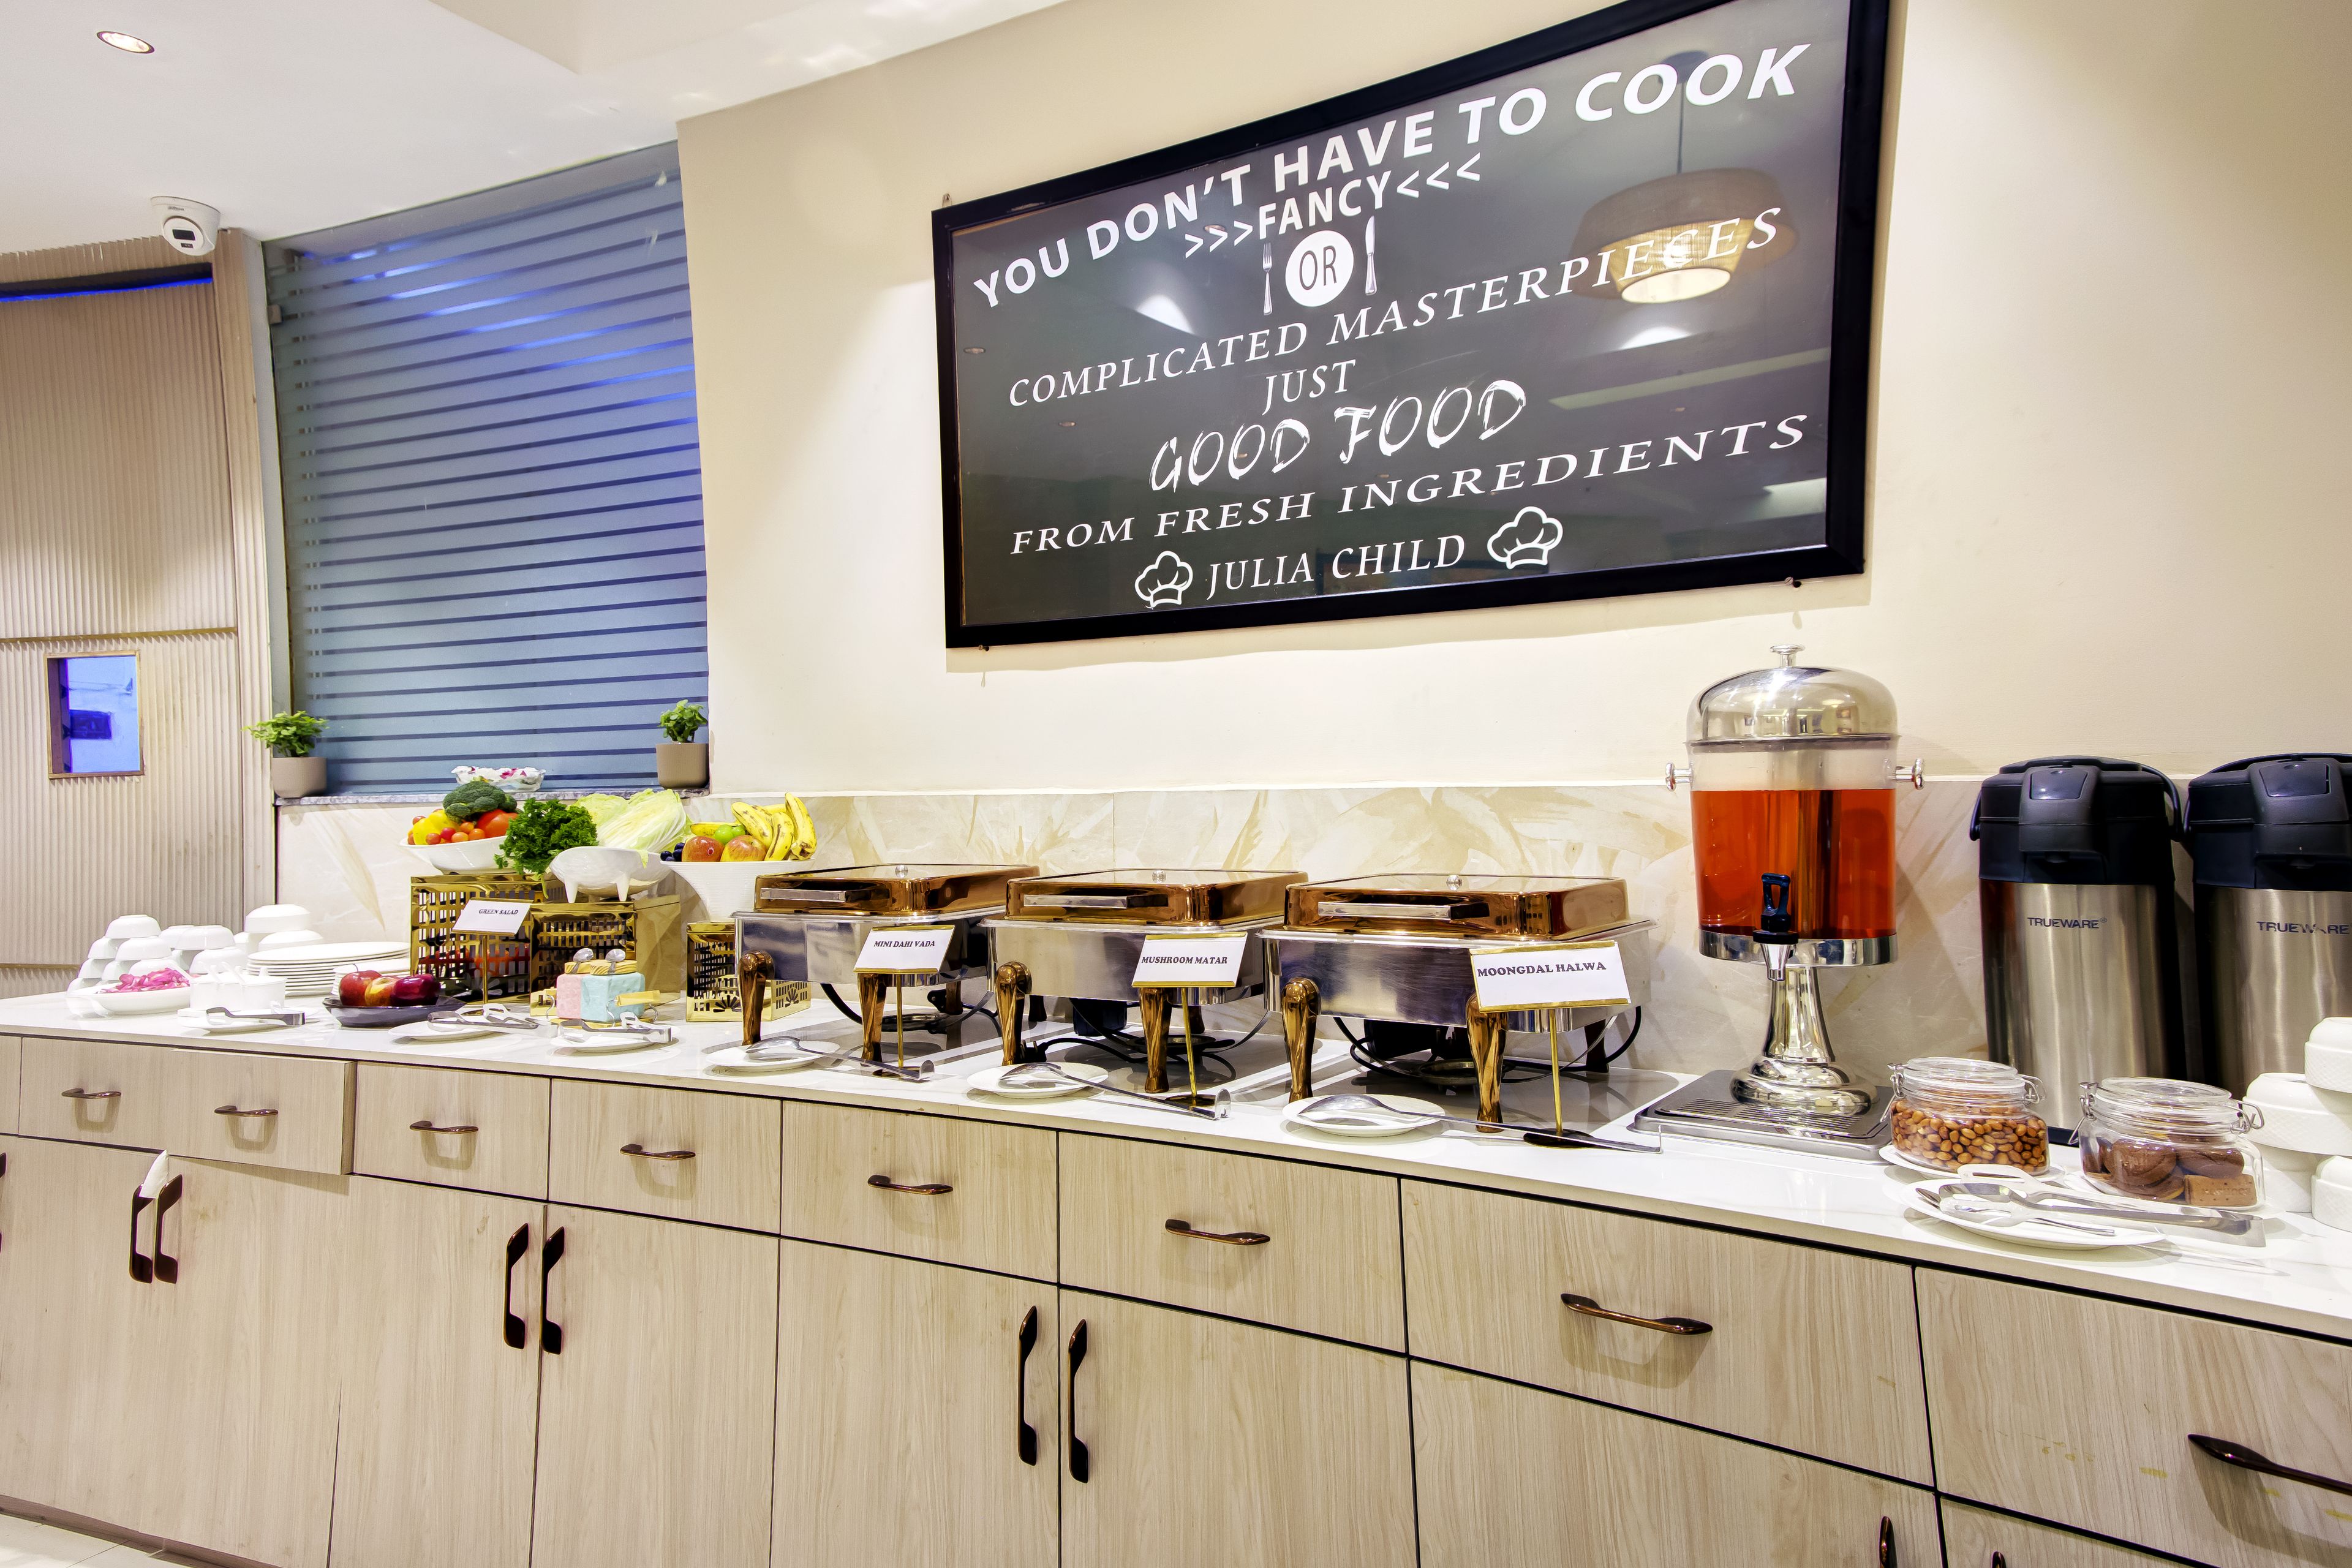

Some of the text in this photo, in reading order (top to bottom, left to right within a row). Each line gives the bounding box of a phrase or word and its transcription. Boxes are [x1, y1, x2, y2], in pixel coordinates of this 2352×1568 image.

[974, 43, 1811, 307] YOU DON'T HAVE TO COOK
[1259, 170, 1391, 239] FANCY
[1298, 246, 1337, 291] OR
[1010, 208, 1781, 406] COMPLICATED MASTERPIECES
[1262, 360, 1355, 415] JUST
[1150, 380, 1526, 492] GOOD FOOD
[1011, 415, 1807, 554] FROM FRESH INGREDIENTS
[1207, 535, 1464, 600] JULIA CHILD
[2027, 918, 2100, 929] TRUEWARE
[1477, 962, 1607, 977] MOONGDAL HALWA
